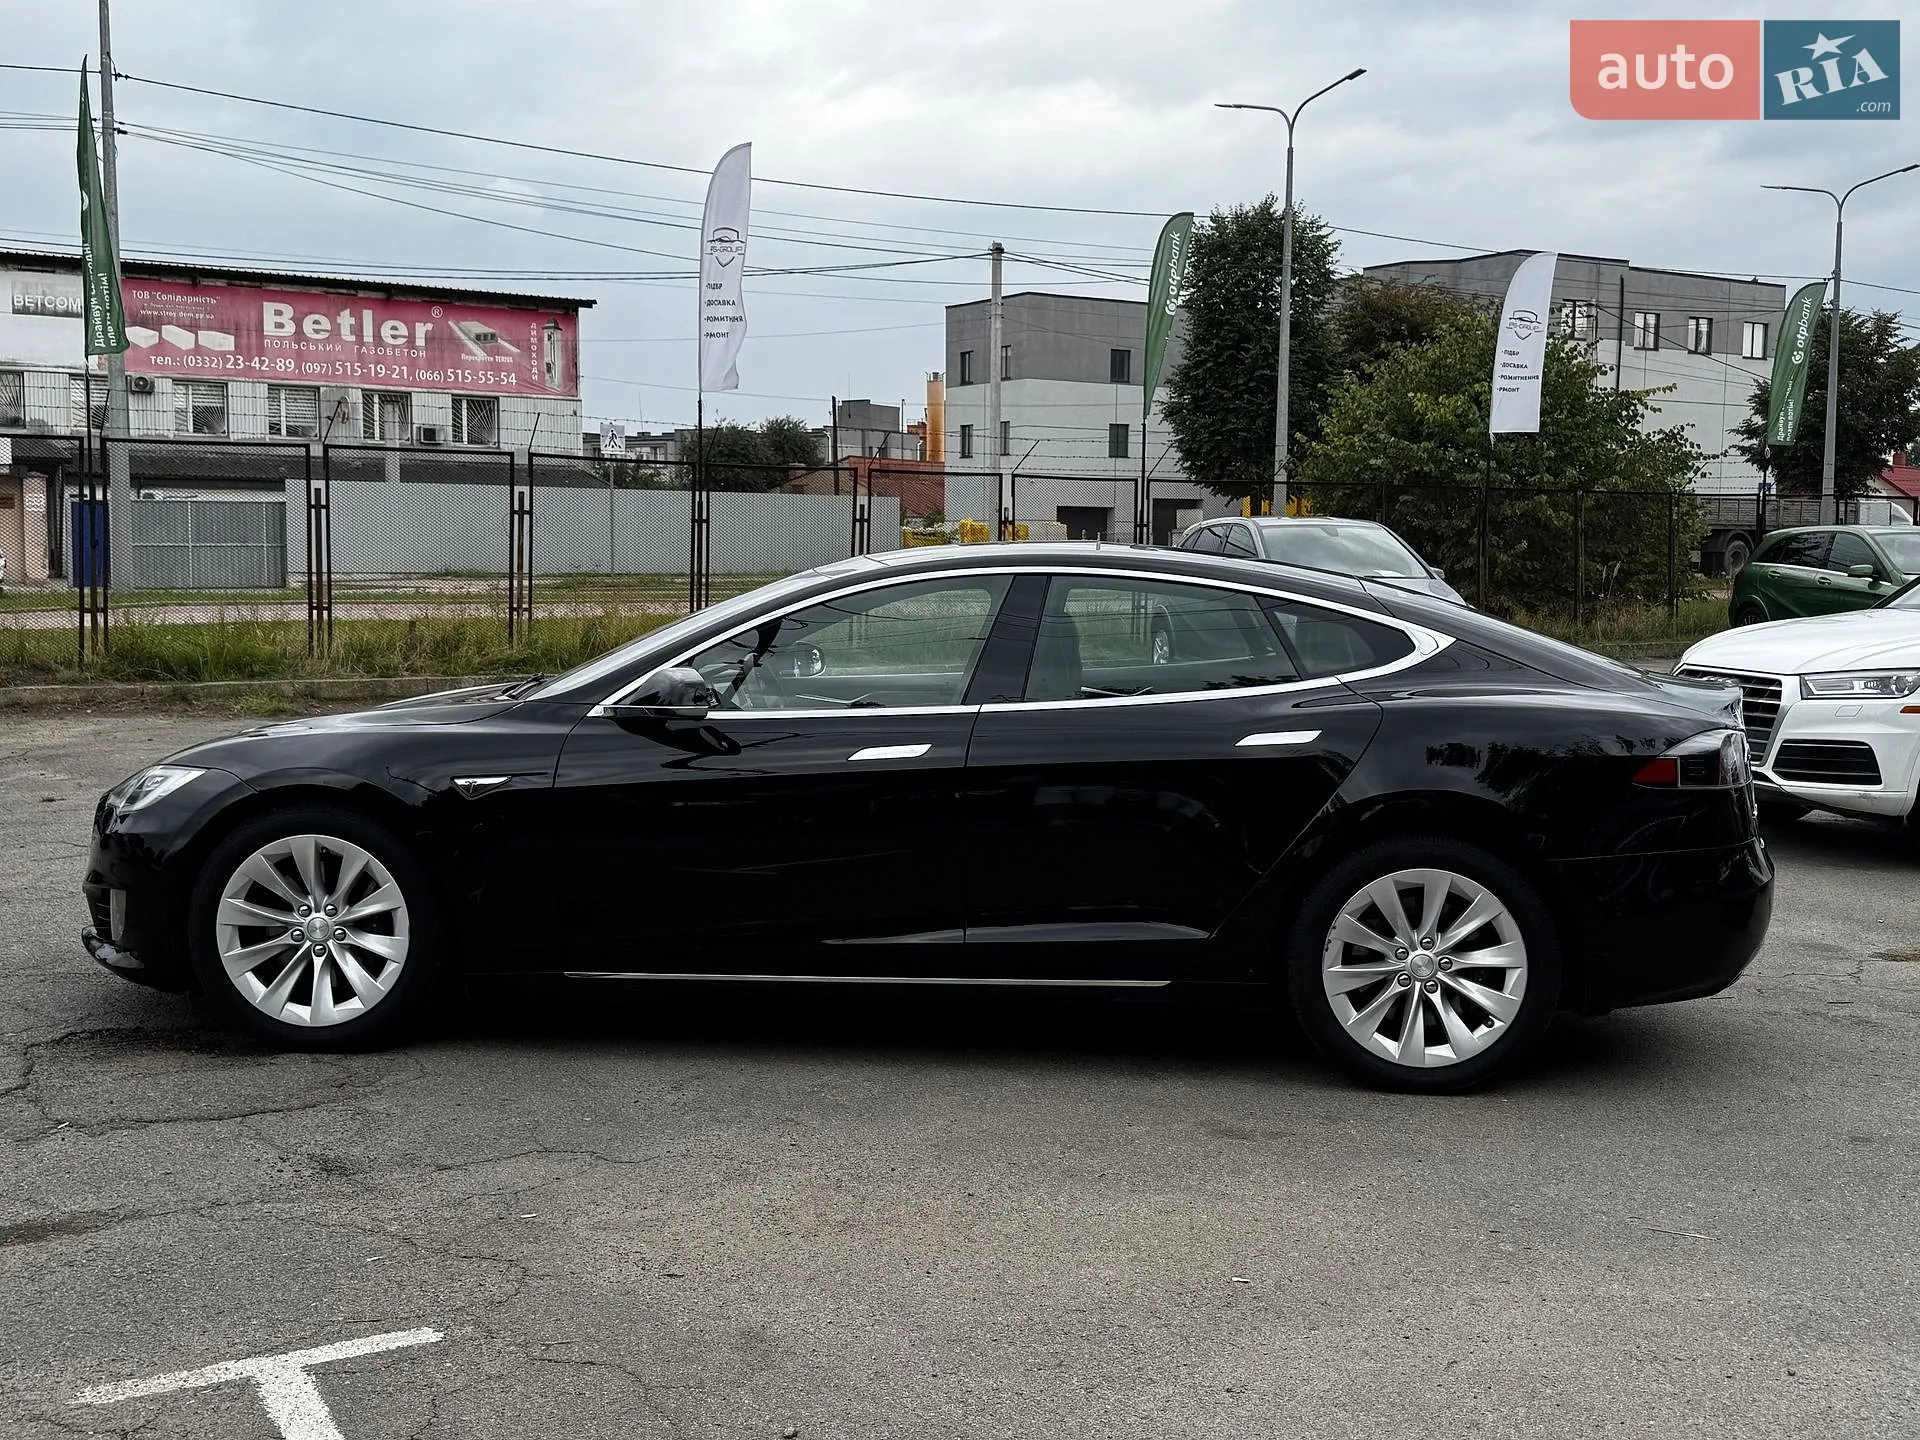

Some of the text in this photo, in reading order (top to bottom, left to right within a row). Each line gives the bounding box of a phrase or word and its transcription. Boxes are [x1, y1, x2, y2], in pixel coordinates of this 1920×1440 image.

[1168, 231, 1181, 294] otpbank
[131, 289, 150, 300] ТОВ
[263, 301, 433, 347] Betler
[1796, 296, 1812, 348] otpbank
[264, 339, 426, 358] ПОЛЬСЬКИЙ ГАЗОБЕТОН
[150, 355, 181, 366] тел.:
[183, 354, 223, 369] (0332)
[301, 361, 332, 375] (097)
[415, 369, 444, 383] (066)
[447, 368, 518, 386] 515-55-54
